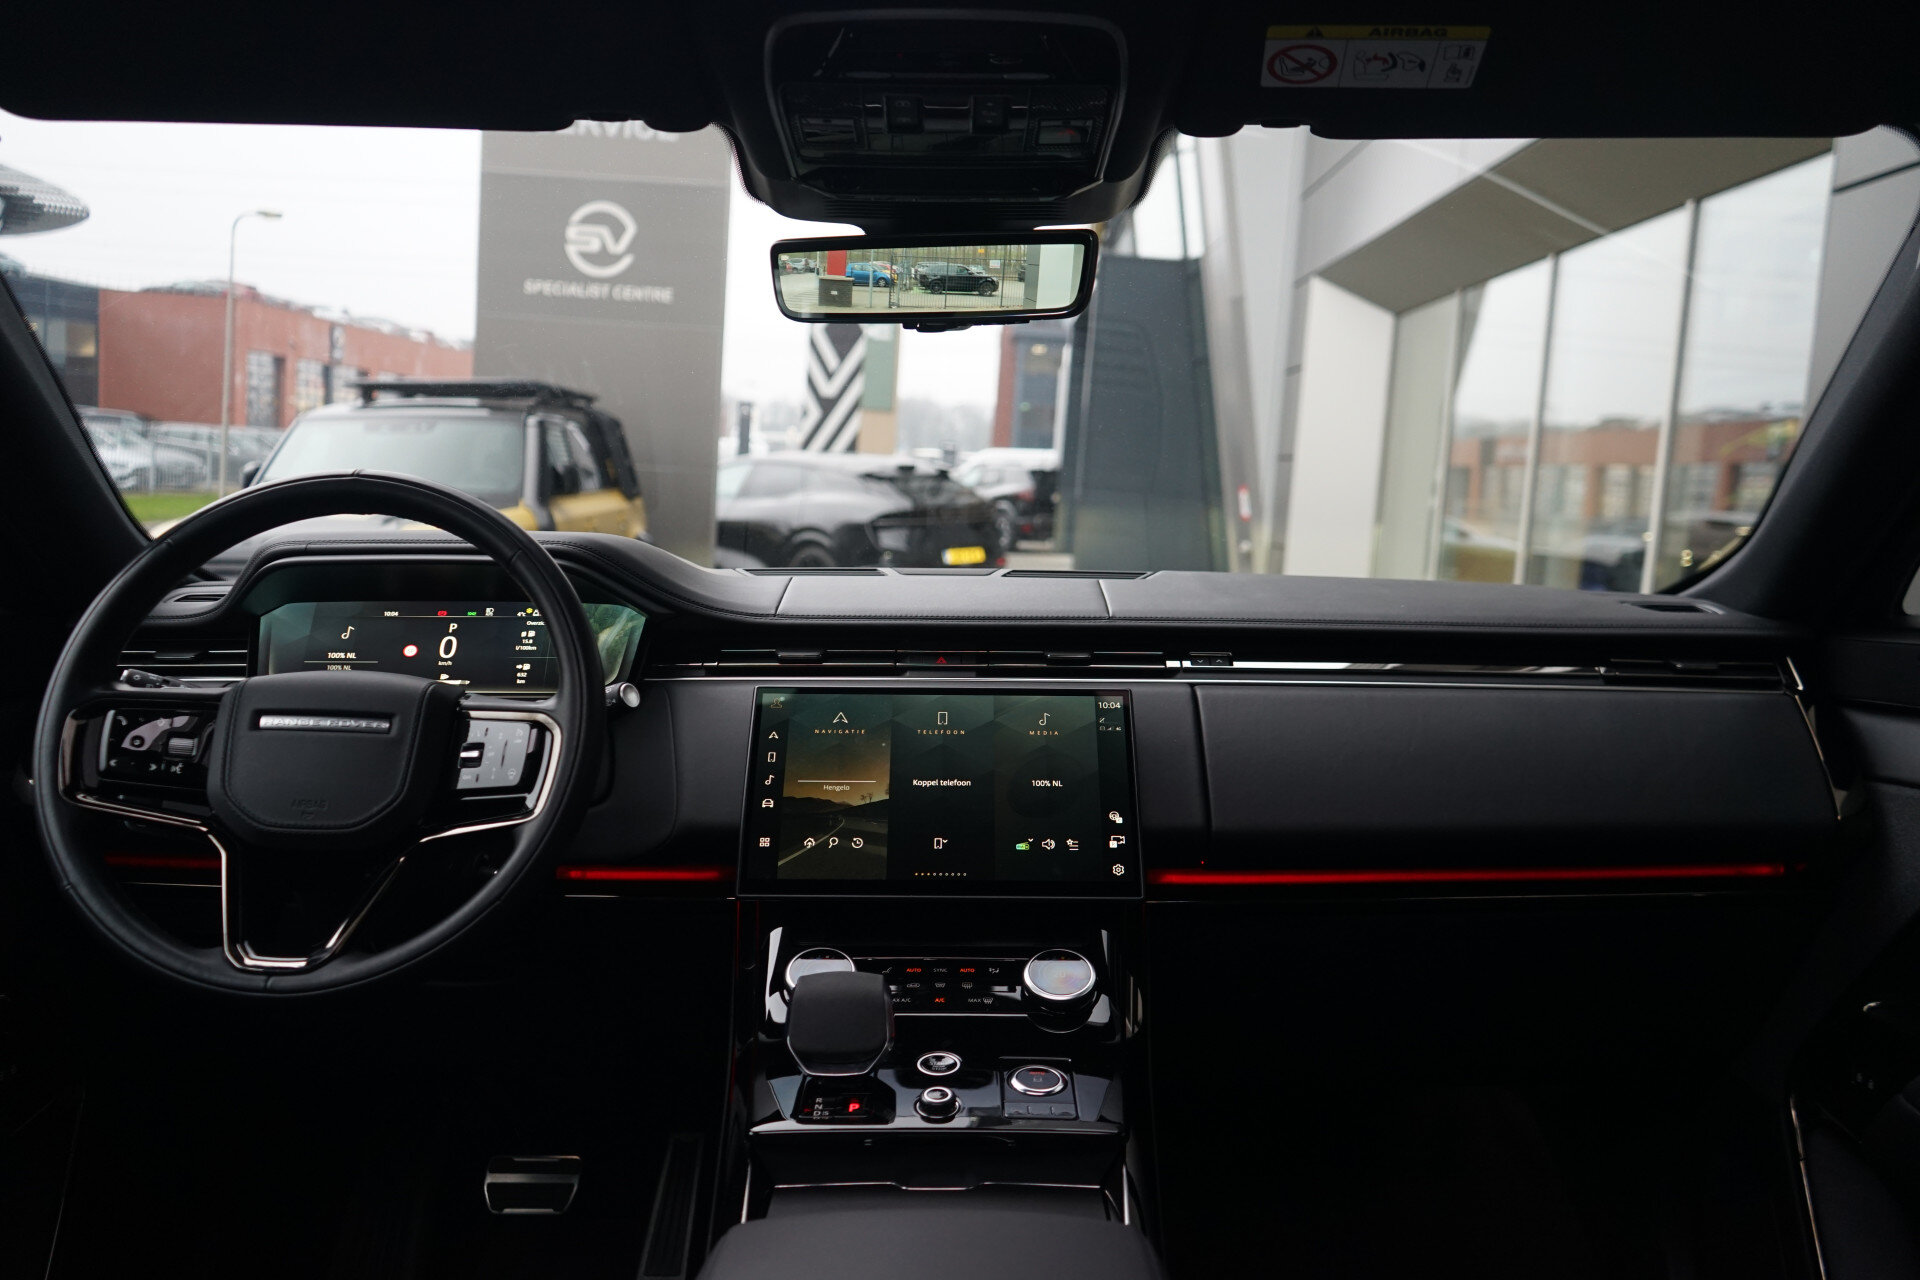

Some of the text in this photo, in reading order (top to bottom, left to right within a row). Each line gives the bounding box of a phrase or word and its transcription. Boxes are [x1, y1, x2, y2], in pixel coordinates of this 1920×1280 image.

[1369, 27, 1448, 37] AIRBAG
[523, 278, 674, 304] SPECIALIST CENTRE
[448, 622, 458, 633] P
[439, 635, 458, 659] 0
[1098, 701, 1121, 709] 10:04
[823, 784, 850, 792] Hengelo
[912, 778, 972, 788] Koppel telefoon
[848, 1102, 861, 1112] P
